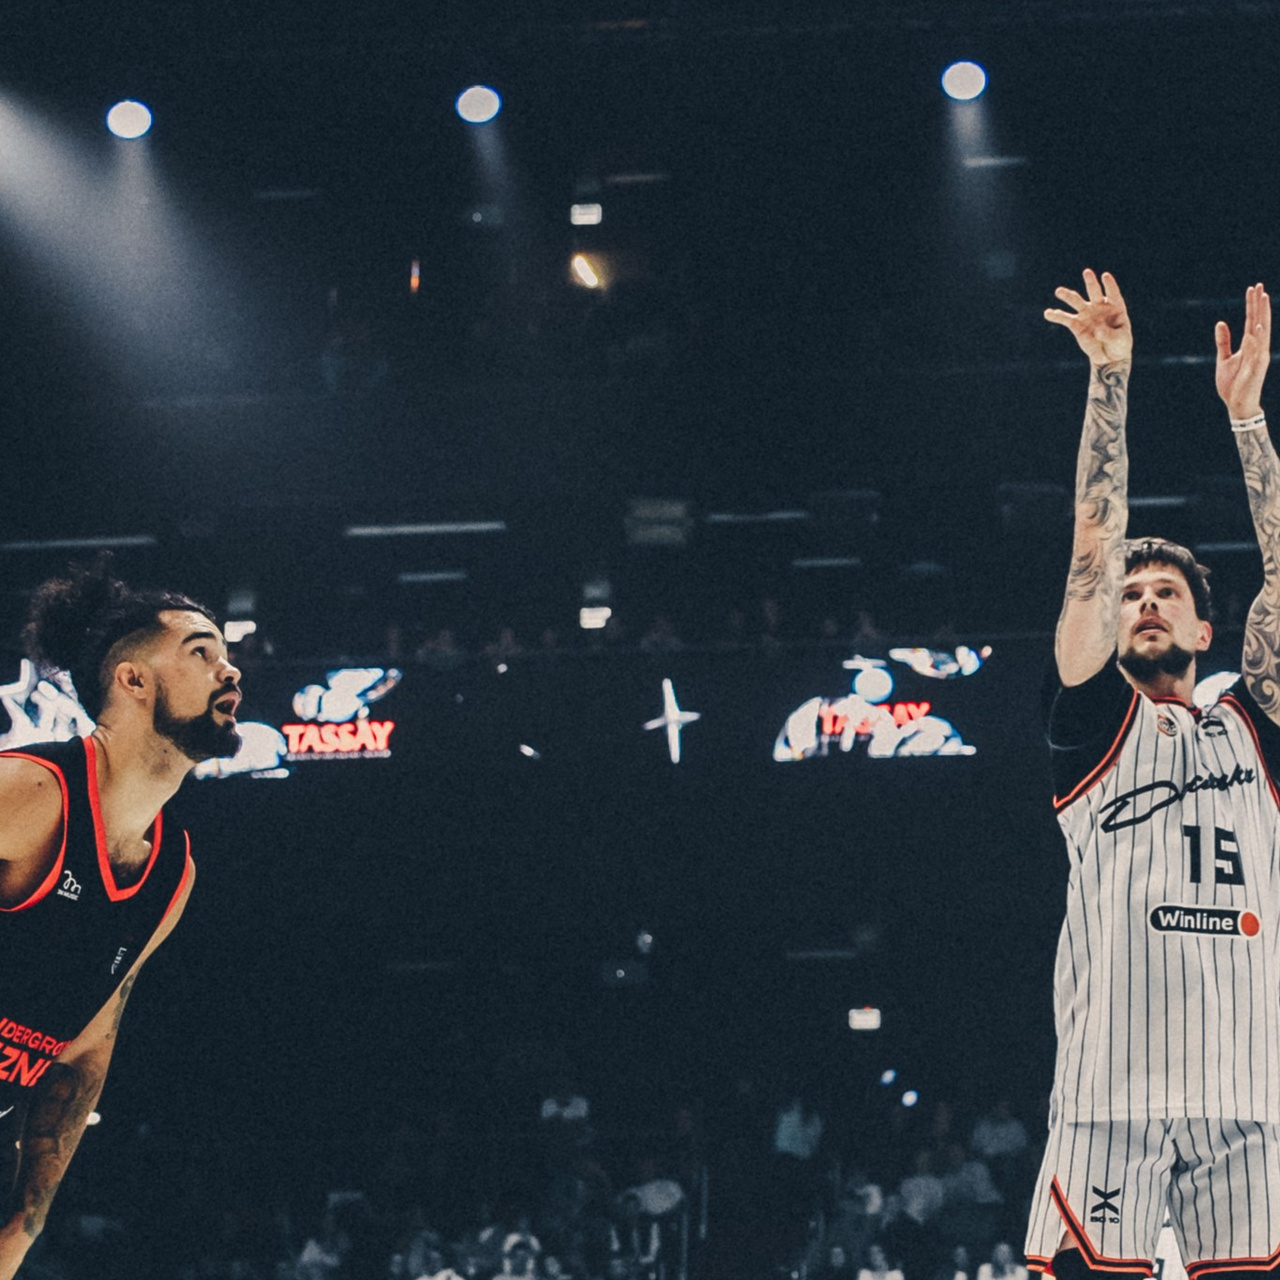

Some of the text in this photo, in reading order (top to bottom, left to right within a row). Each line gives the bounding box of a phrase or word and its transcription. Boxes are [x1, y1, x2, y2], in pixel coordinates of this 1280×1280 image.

[282, 720, 395, 753] TASSAY
[1183, 825, 1245, 885] 15
[1158, 909, 1234, 931] Winline
